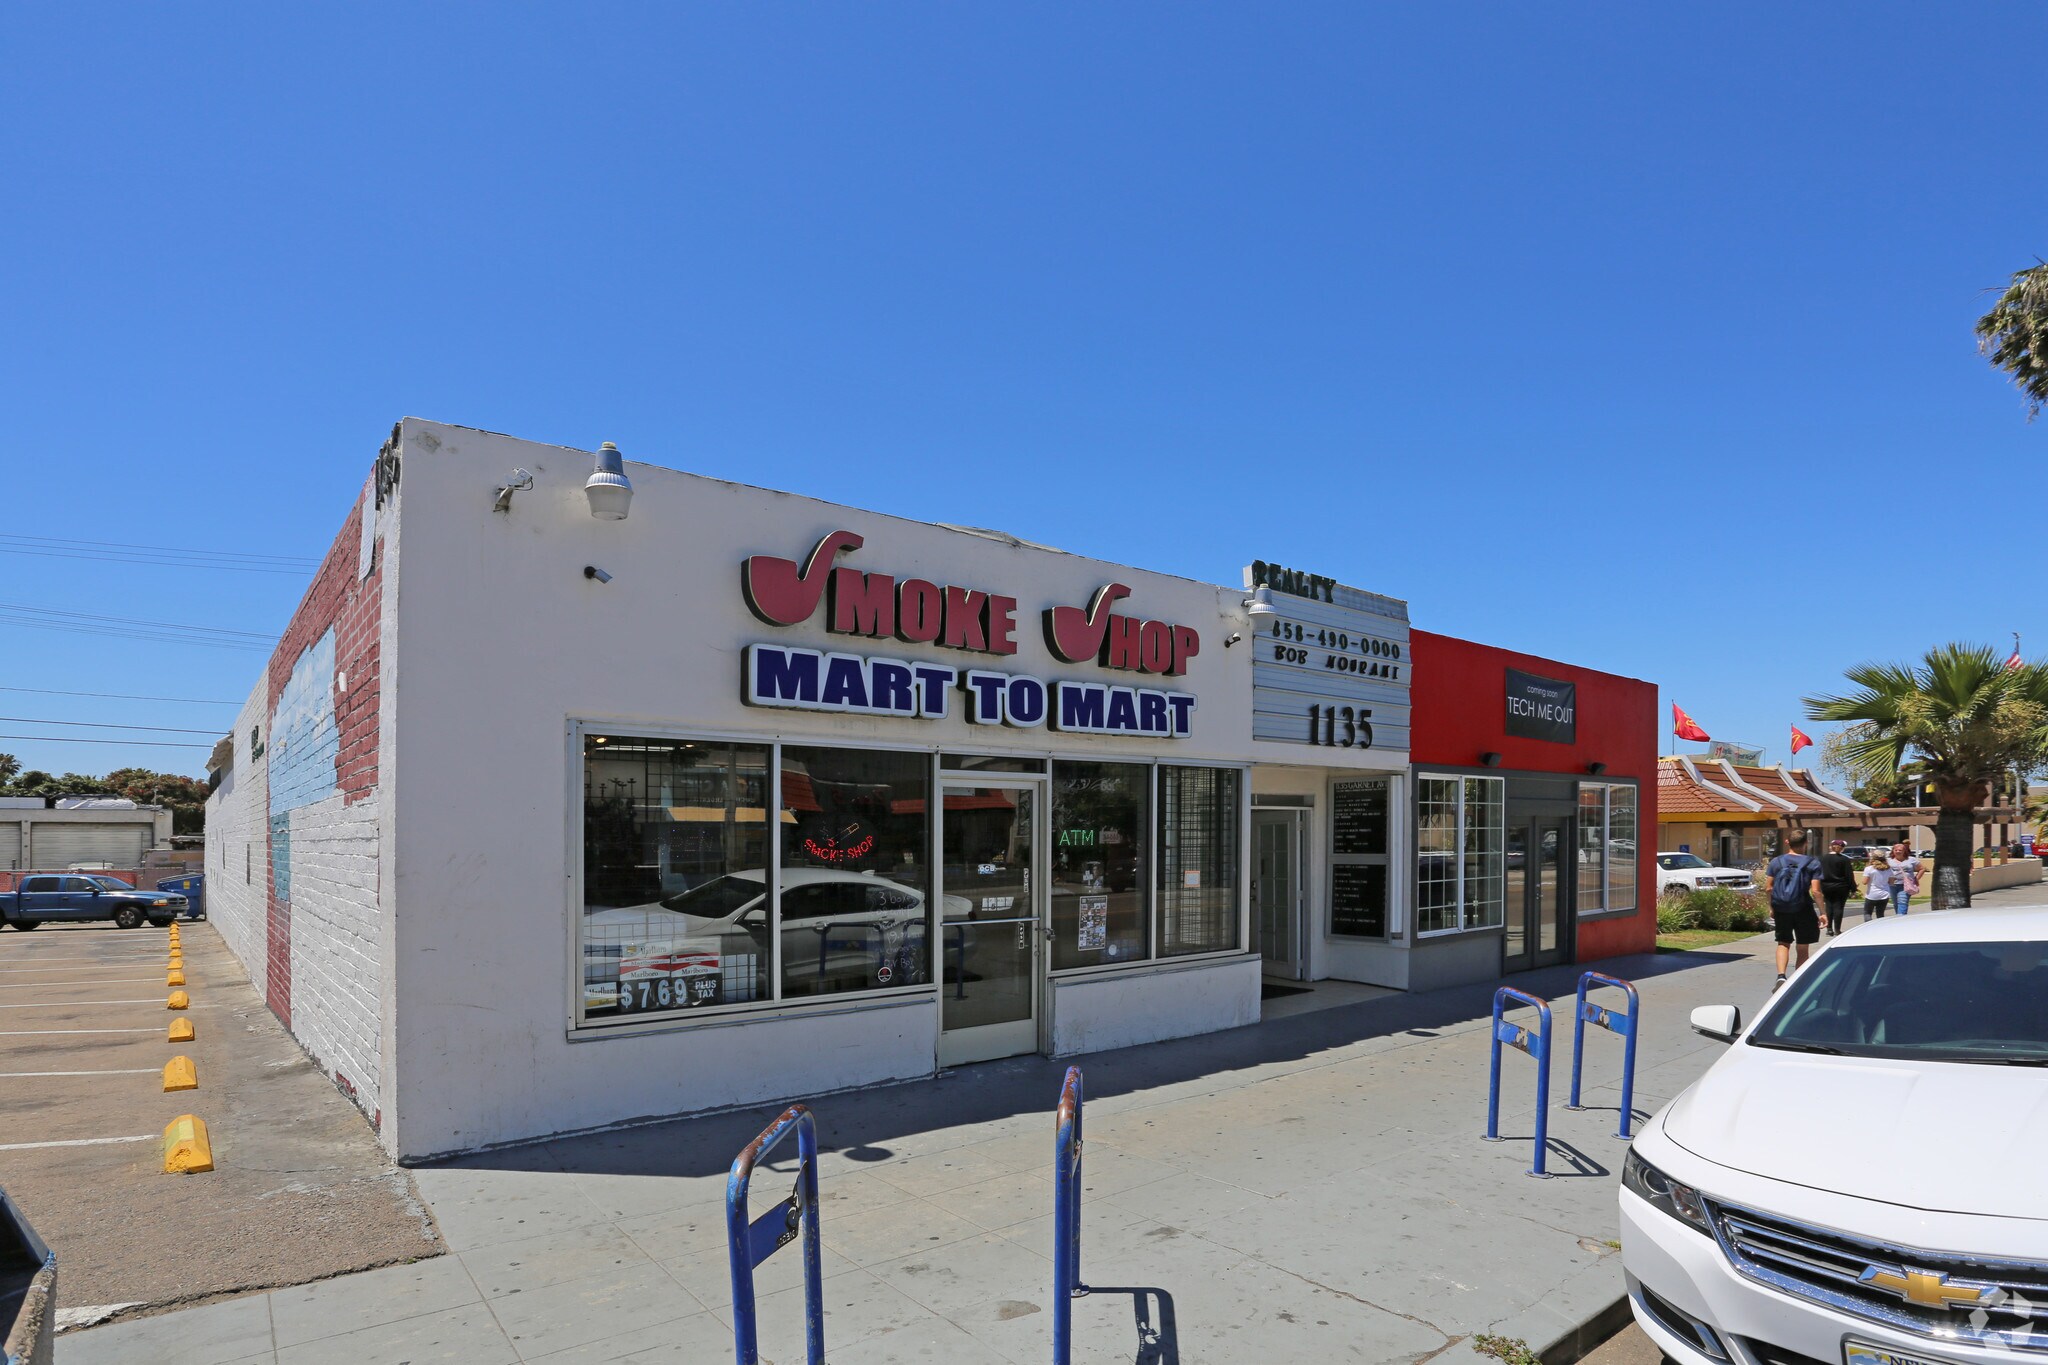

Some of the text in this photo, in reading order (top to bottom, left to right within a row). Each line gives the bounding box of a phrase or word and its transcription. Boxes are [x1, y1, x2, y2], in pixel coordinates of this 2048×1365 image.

[1252, 559, 1336, 603] REALTY
[1272, 620, 1400, 659] 858-490-0000
[1274, 645, 1308, 664] BOB
[756, 648, 1195, 733] MART TO MART
[1526, 685, 1558, 698] coming soon
[1507, 696, 1573, 724] TECH ME OUT
[1308, 703, 1373, 749] 1135
[1059, 829, 1094, 846] ATM
[630, 967, 709, 980] Marlboro Marlboro
[694, 980, 717, 990] PLUS
[697, 988, 715, 999] TAX
